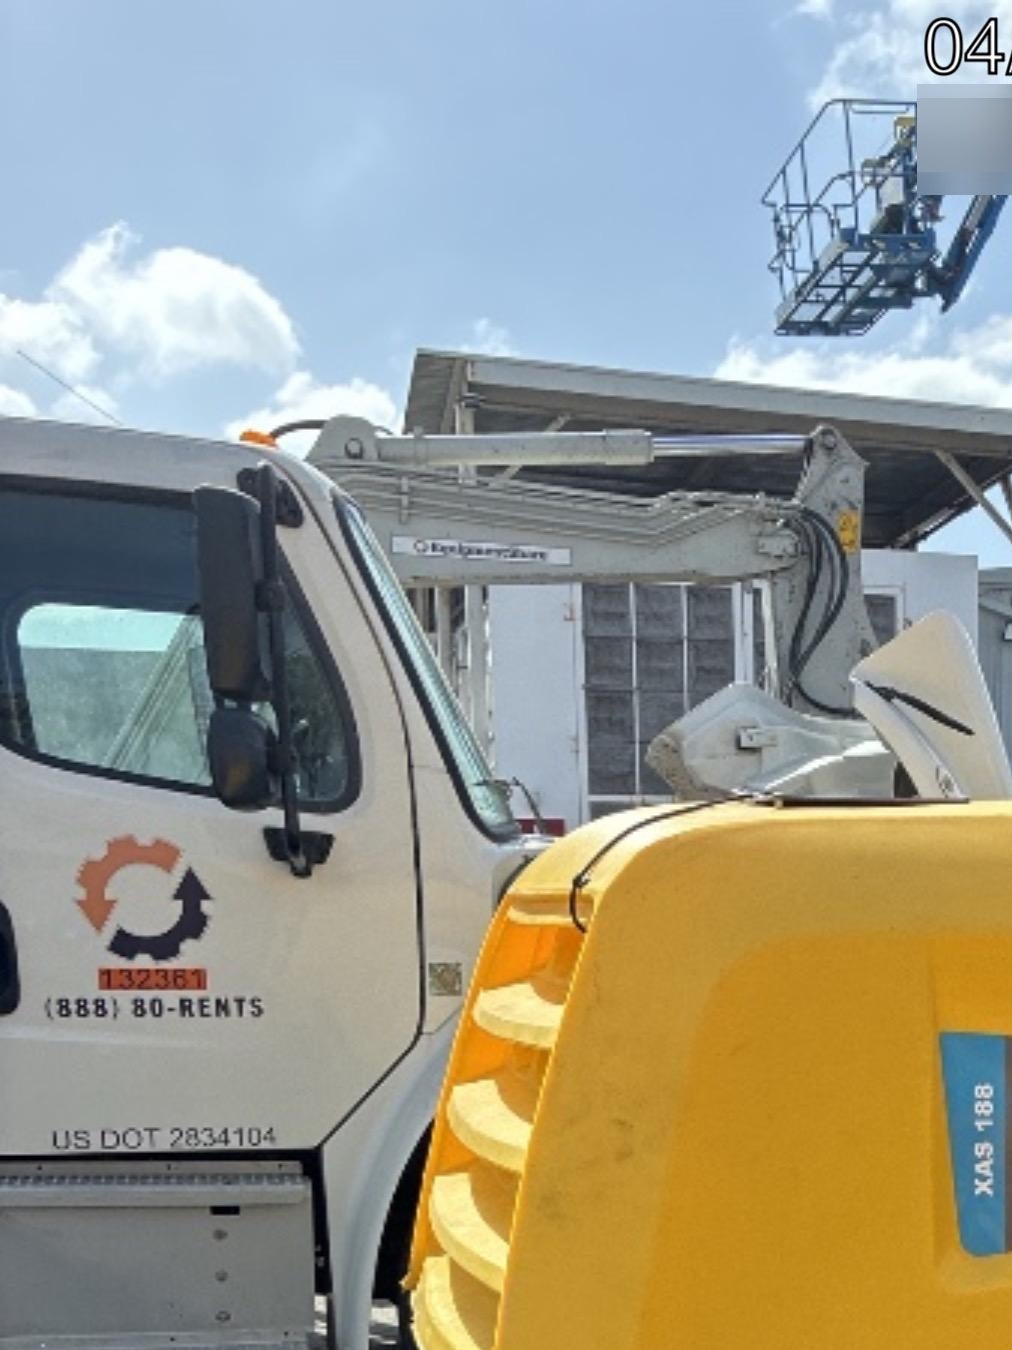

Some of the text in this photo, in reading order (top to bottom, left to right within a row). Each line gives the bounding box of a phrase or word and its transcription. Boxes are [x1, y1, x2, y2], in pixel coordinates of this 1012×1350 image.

[101, 968, 205, 990] 132361
[44, 996, 265, 1020] (888) 80-RENTS
[52, 1126, 276, 1150] US DOT 2834104
[974, 1083, 994, 1197] XAS 188
